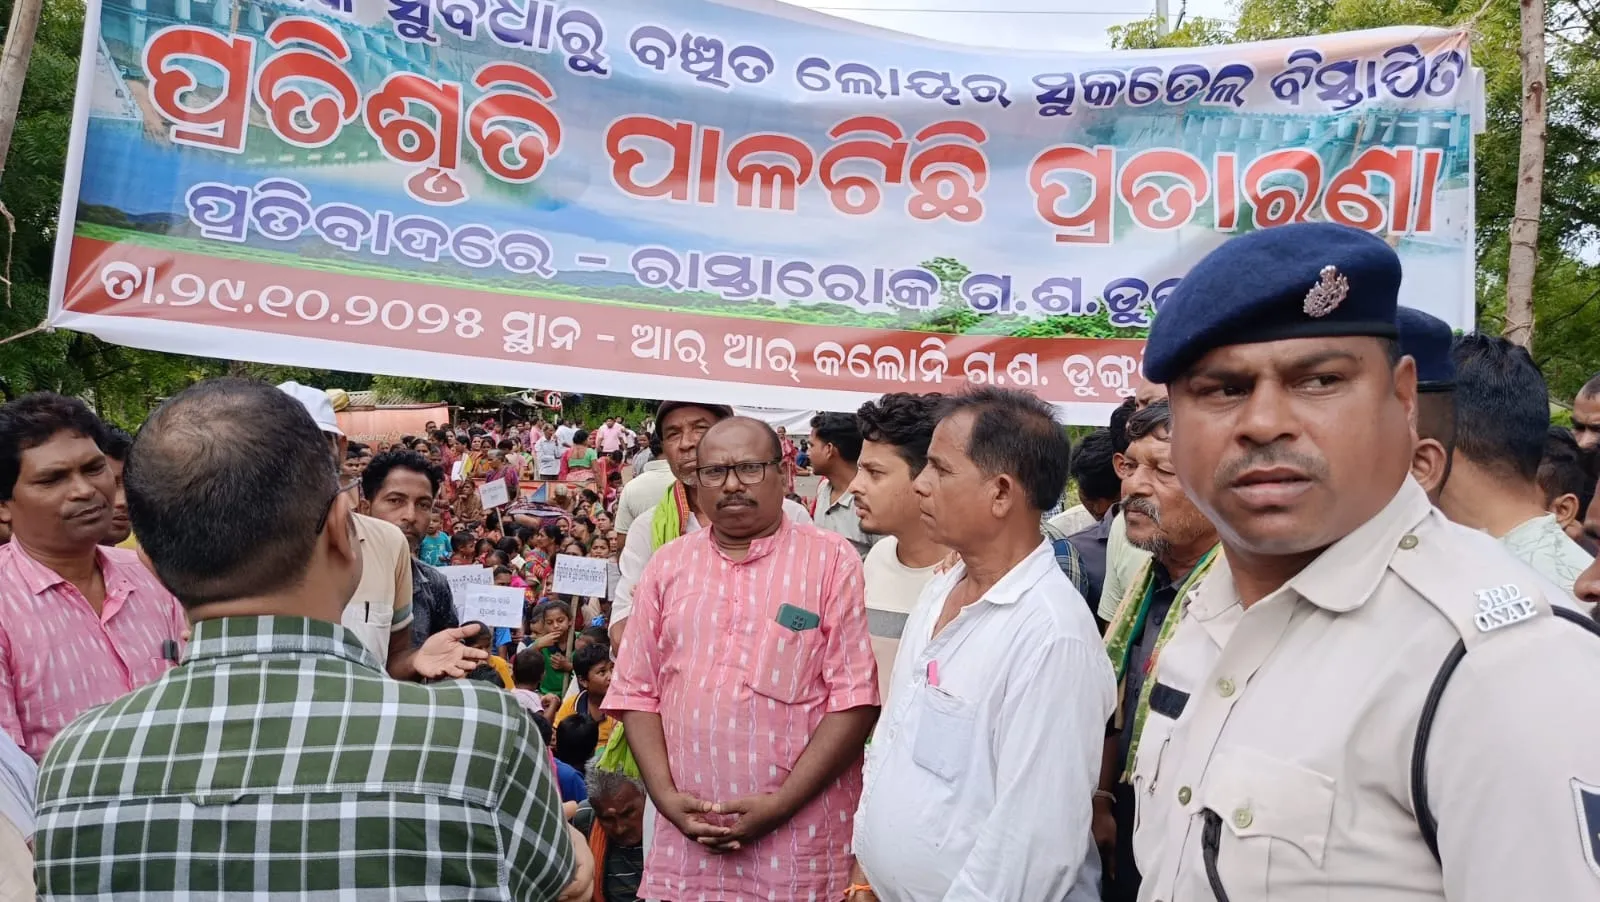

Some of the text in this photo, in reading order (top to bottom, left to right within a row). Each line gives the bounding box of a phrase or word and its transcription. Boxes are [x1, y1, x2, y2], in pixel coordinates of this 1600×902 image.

[605, 115, 988, 223] ପାଳଟିଛି
[1028, 146, 1443, 243] ପ୍ରତାରଣା
[188, 180, 554, 277] ପ୍ରତିବାଦରେ
[630, 247, 939, 307] ରାସ୍ତାରୋକ
[501, 310, 582, 355] ସ୍ଥାନ
[630, 323, 710, 375] ଆର୍
[722, 332, 801, 383] ଆର୍
[812, 336, 949, 384] କଲୋନି
[1473, 584, 1520, 610] 3RD
